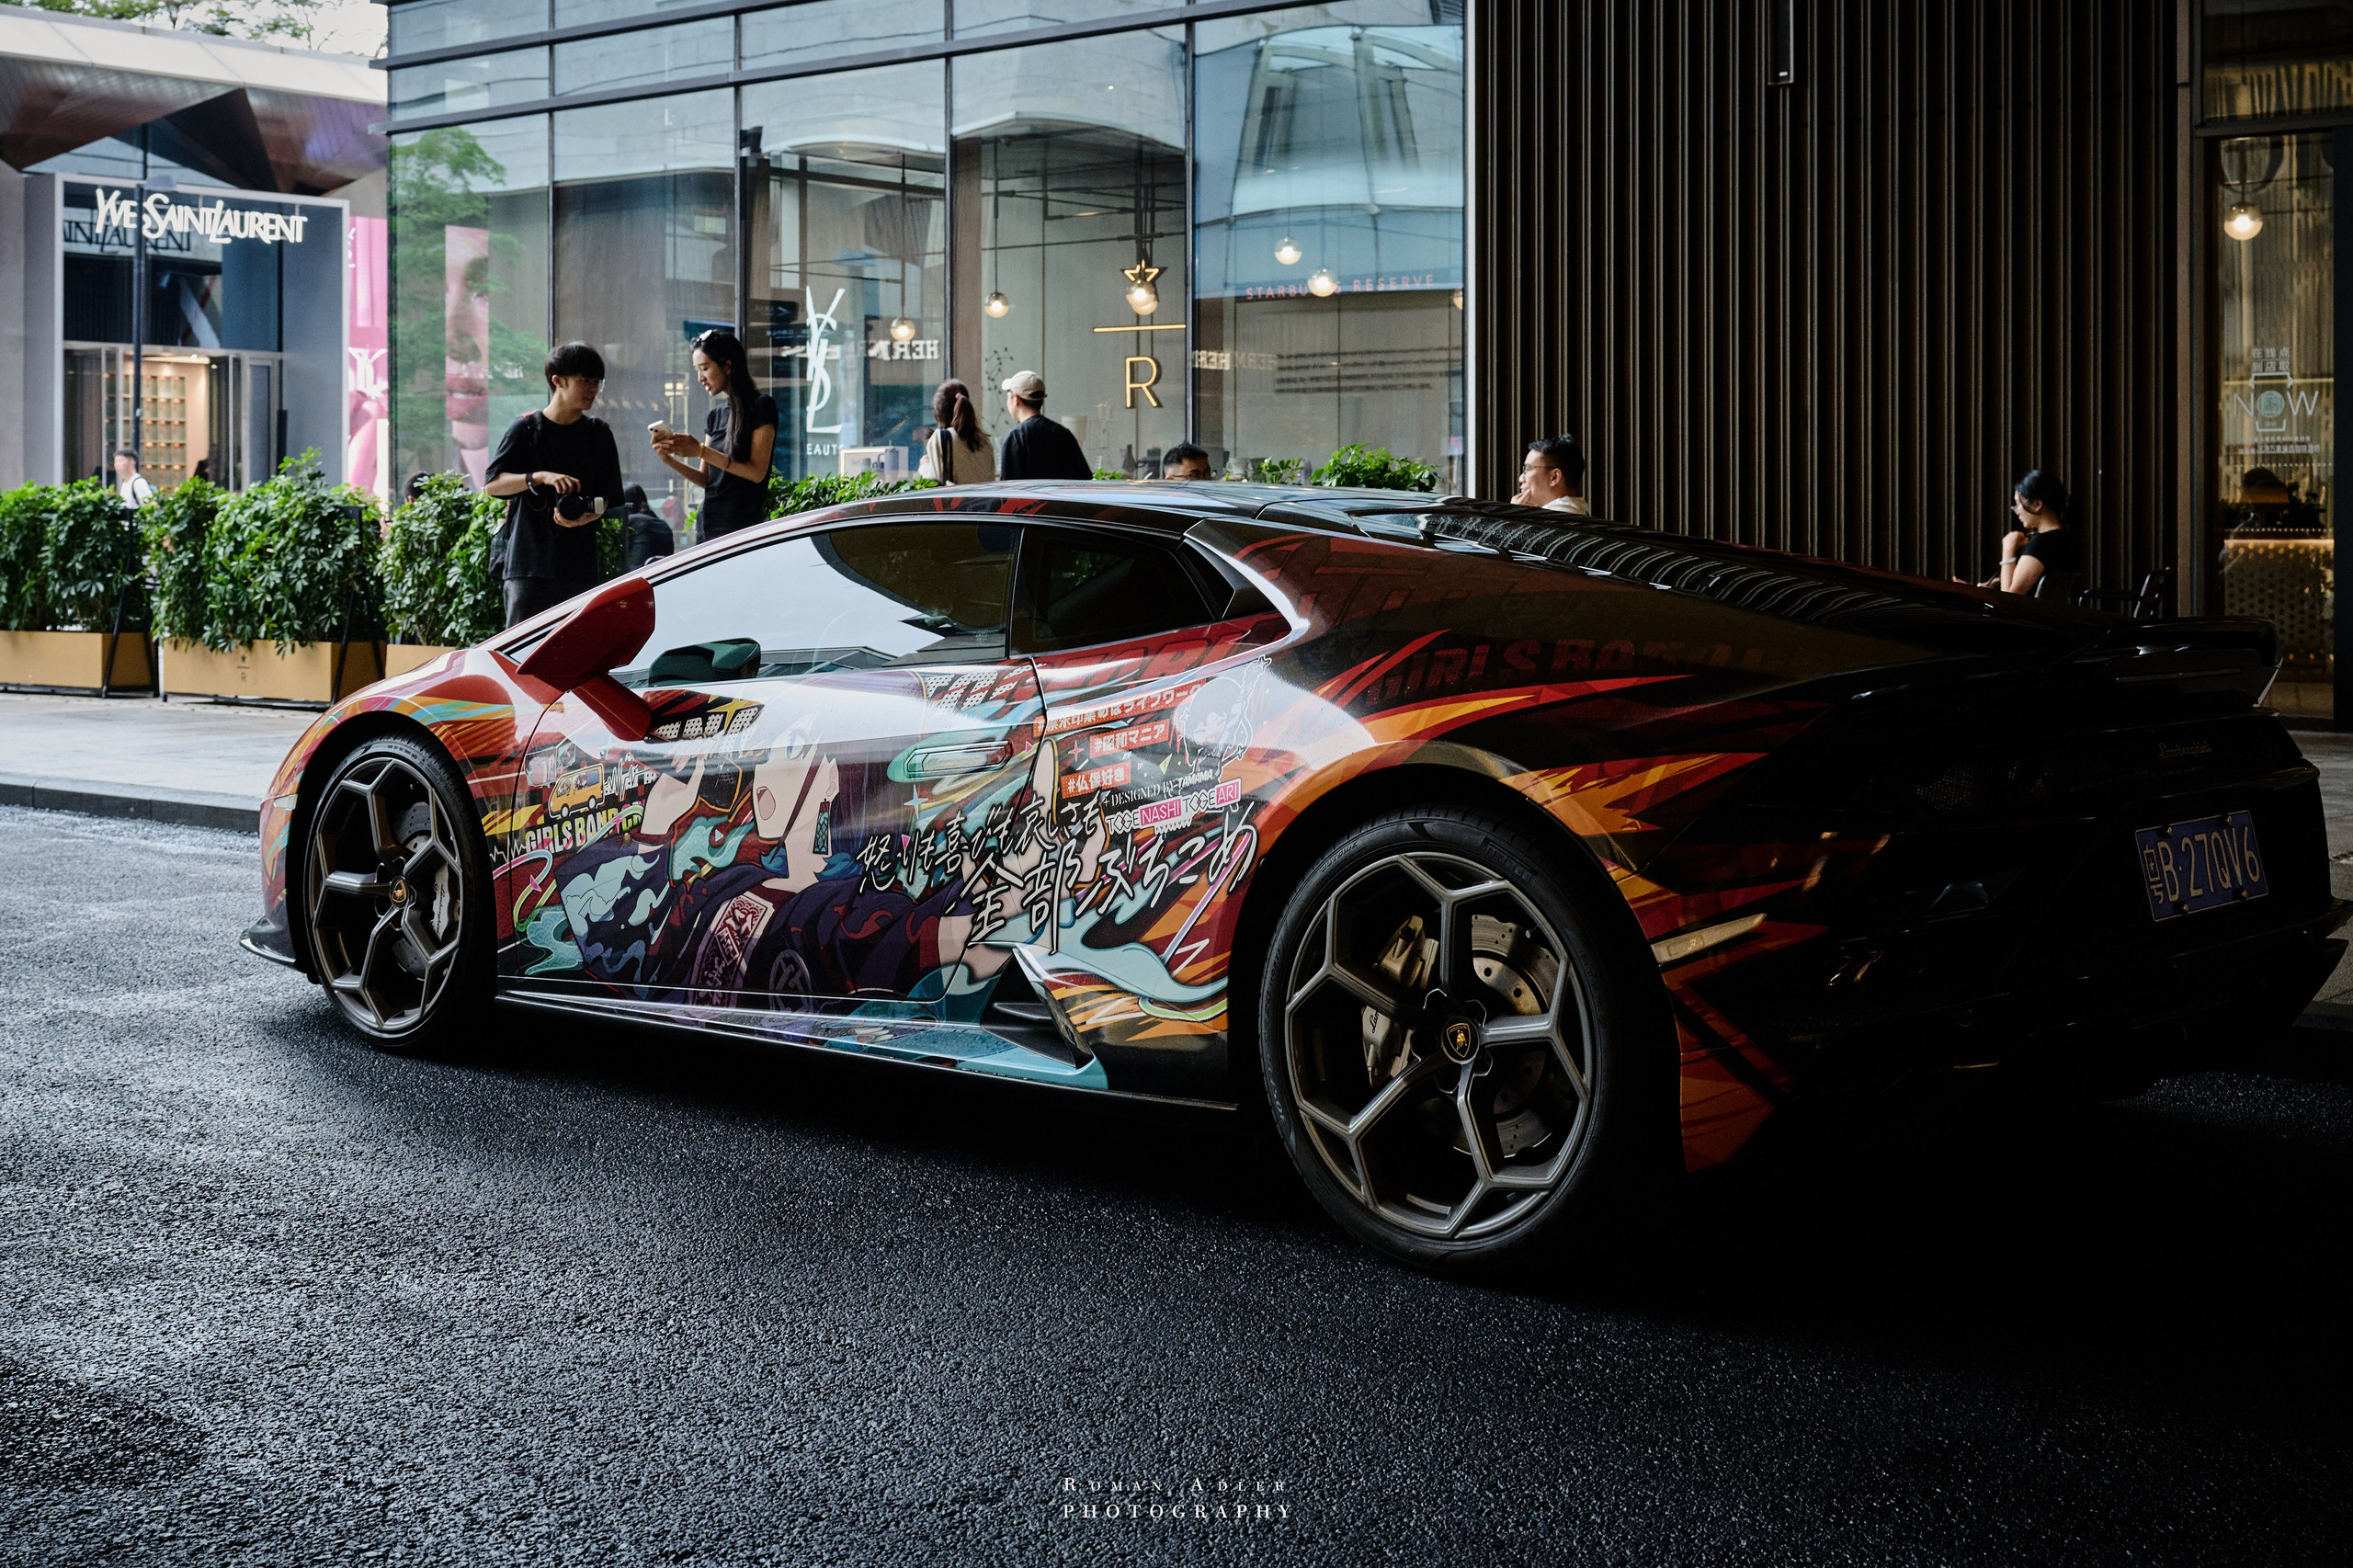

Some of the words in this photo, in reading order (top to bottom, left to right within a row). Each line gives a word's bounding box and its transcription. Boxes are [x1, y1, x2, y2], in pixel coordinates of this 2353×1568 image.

[209, 199, 308, 244] LAURENT
[1245, 279, 1342, 301] STARBUS
[1353, 274, 1434, 292] RESERVE
[1125, 355, 1162, 408] R
[526, 820, 574, 854] GIRLS
